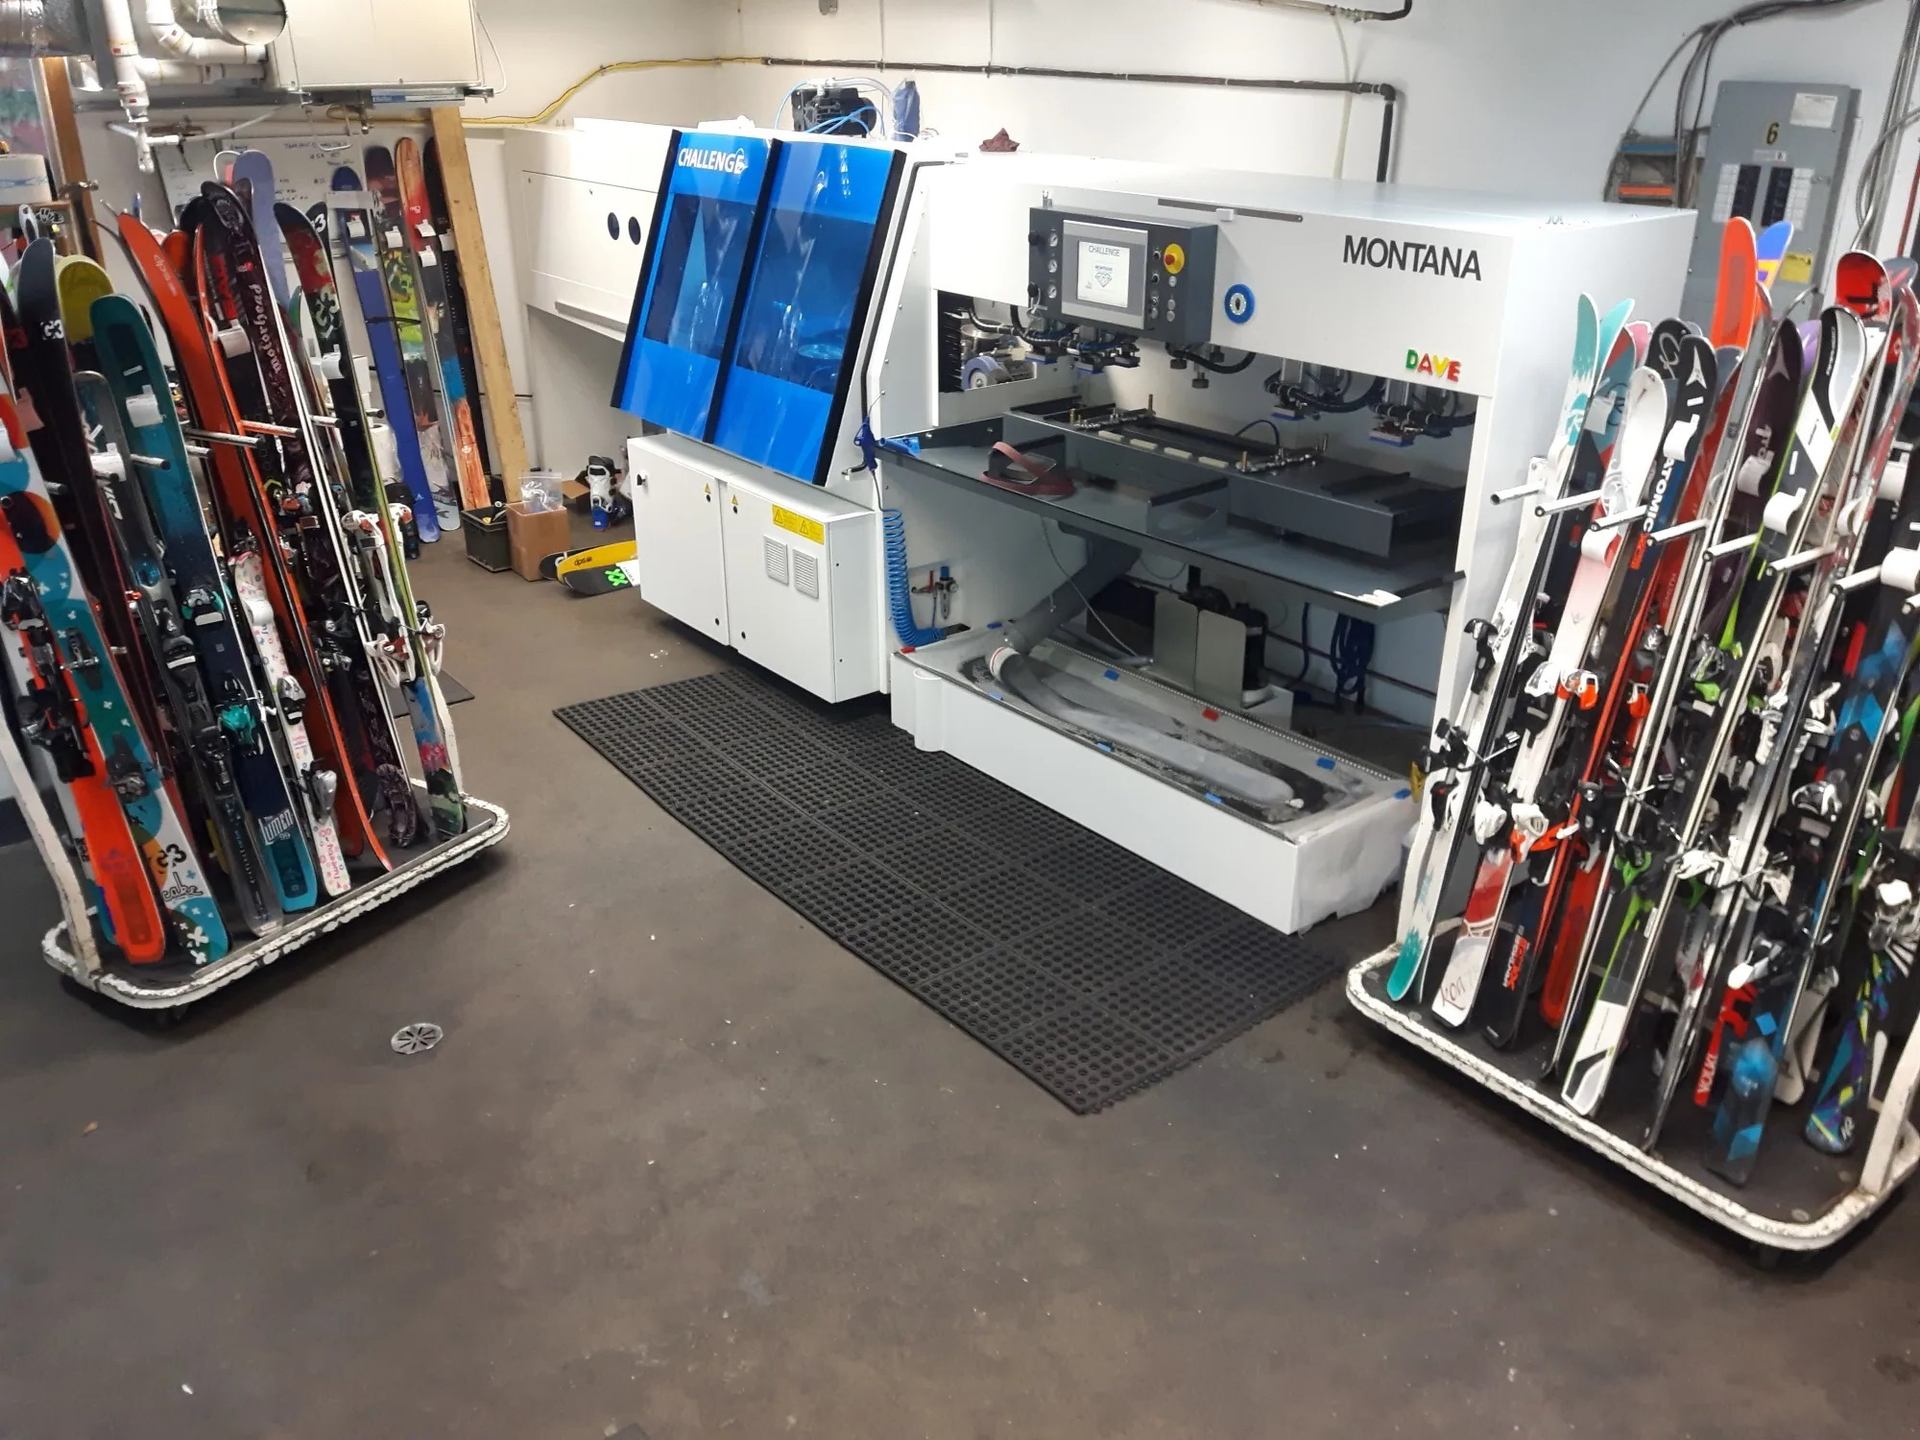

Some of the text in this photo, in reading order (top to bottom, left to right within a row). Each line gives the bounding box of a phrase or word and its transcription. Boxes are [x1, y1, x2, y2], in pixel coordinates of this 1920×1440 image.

[1766, 122, 1780, 145] 6
[678, 147, 747, 174] CHALLENGE
[1088, 245, 1121, 257] CHALLENGE
[1343, 235, 1482, 281] MONTANA
[1405, 349, 1462, 382] DAVE
